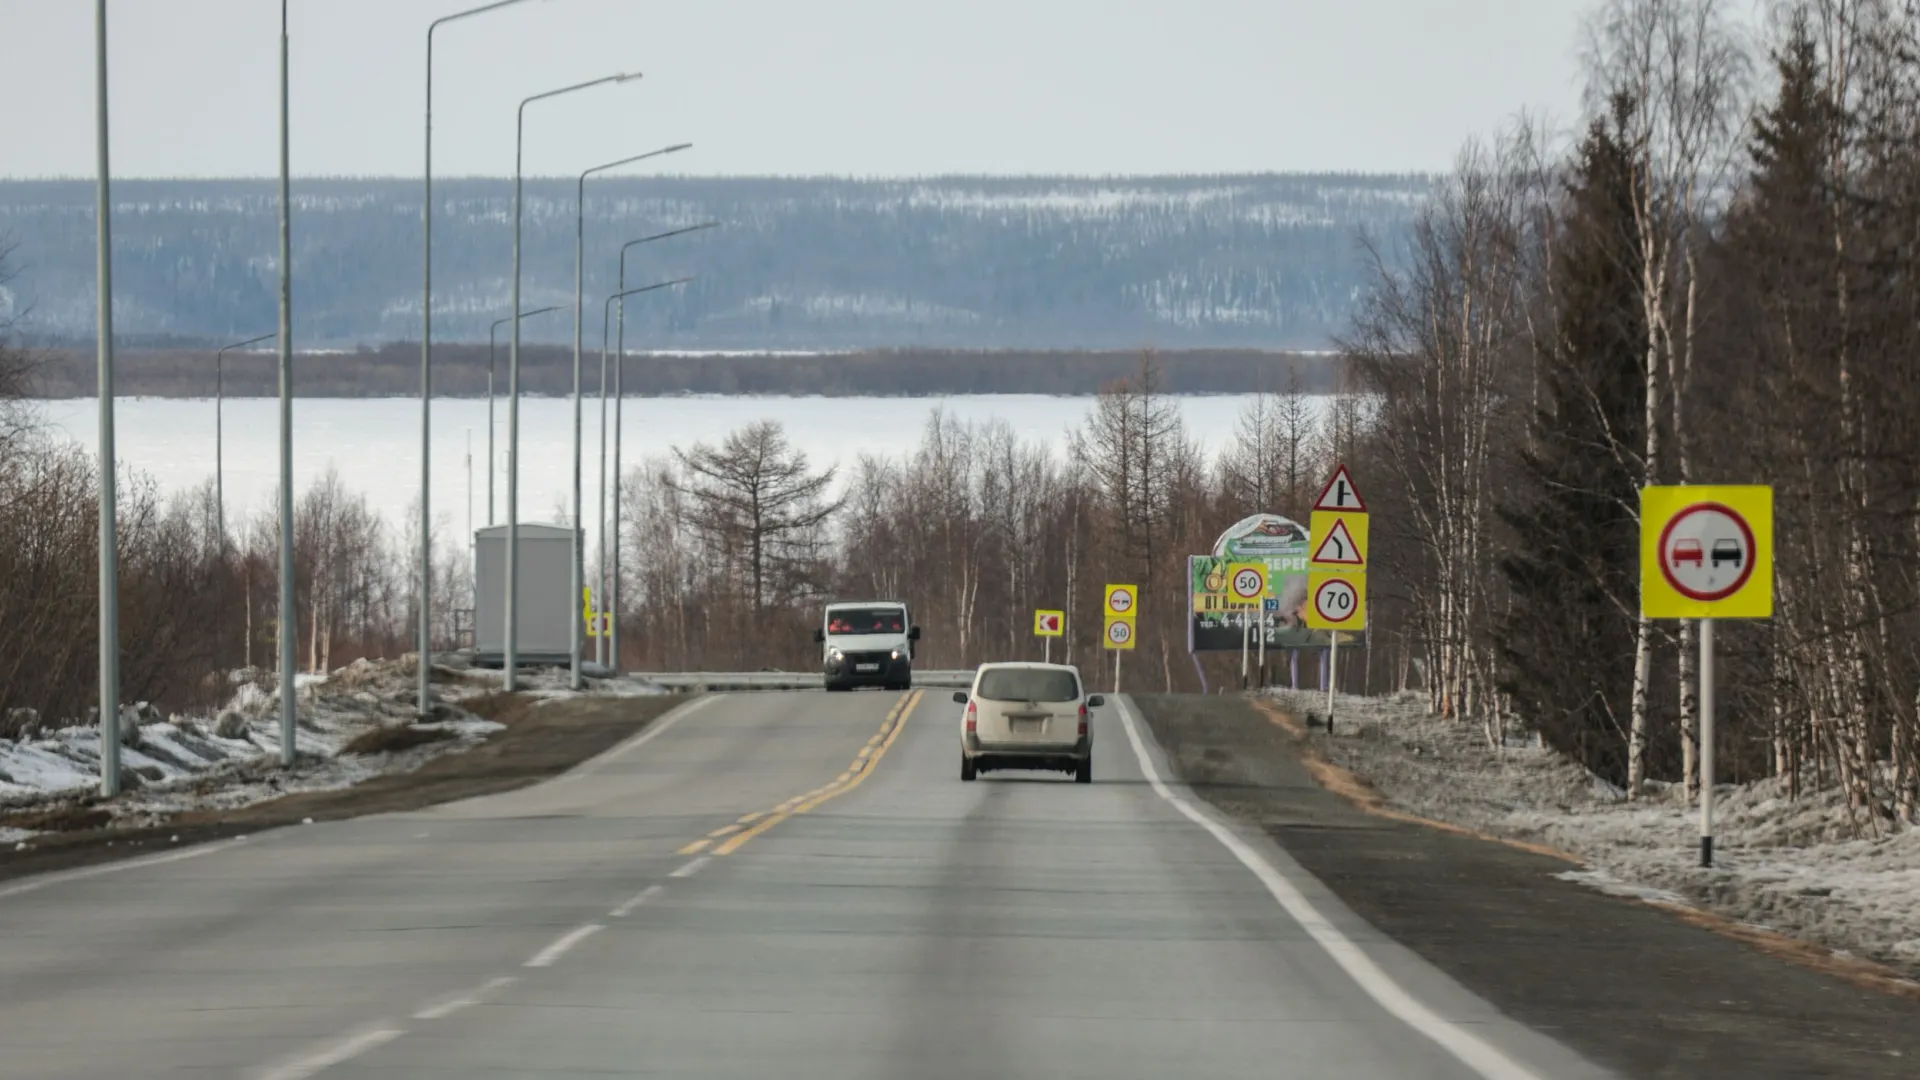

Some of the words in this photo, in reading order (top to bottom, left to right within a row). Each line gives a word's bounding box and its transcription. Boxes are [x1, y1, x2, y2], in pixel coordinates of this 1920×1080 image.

[1240, 577, 1257, 590] 50
[1267, 600, 1277, 610] 12
[1327, 591, 1350, 610] 70
[1113, 627, 1127, 638] 50
